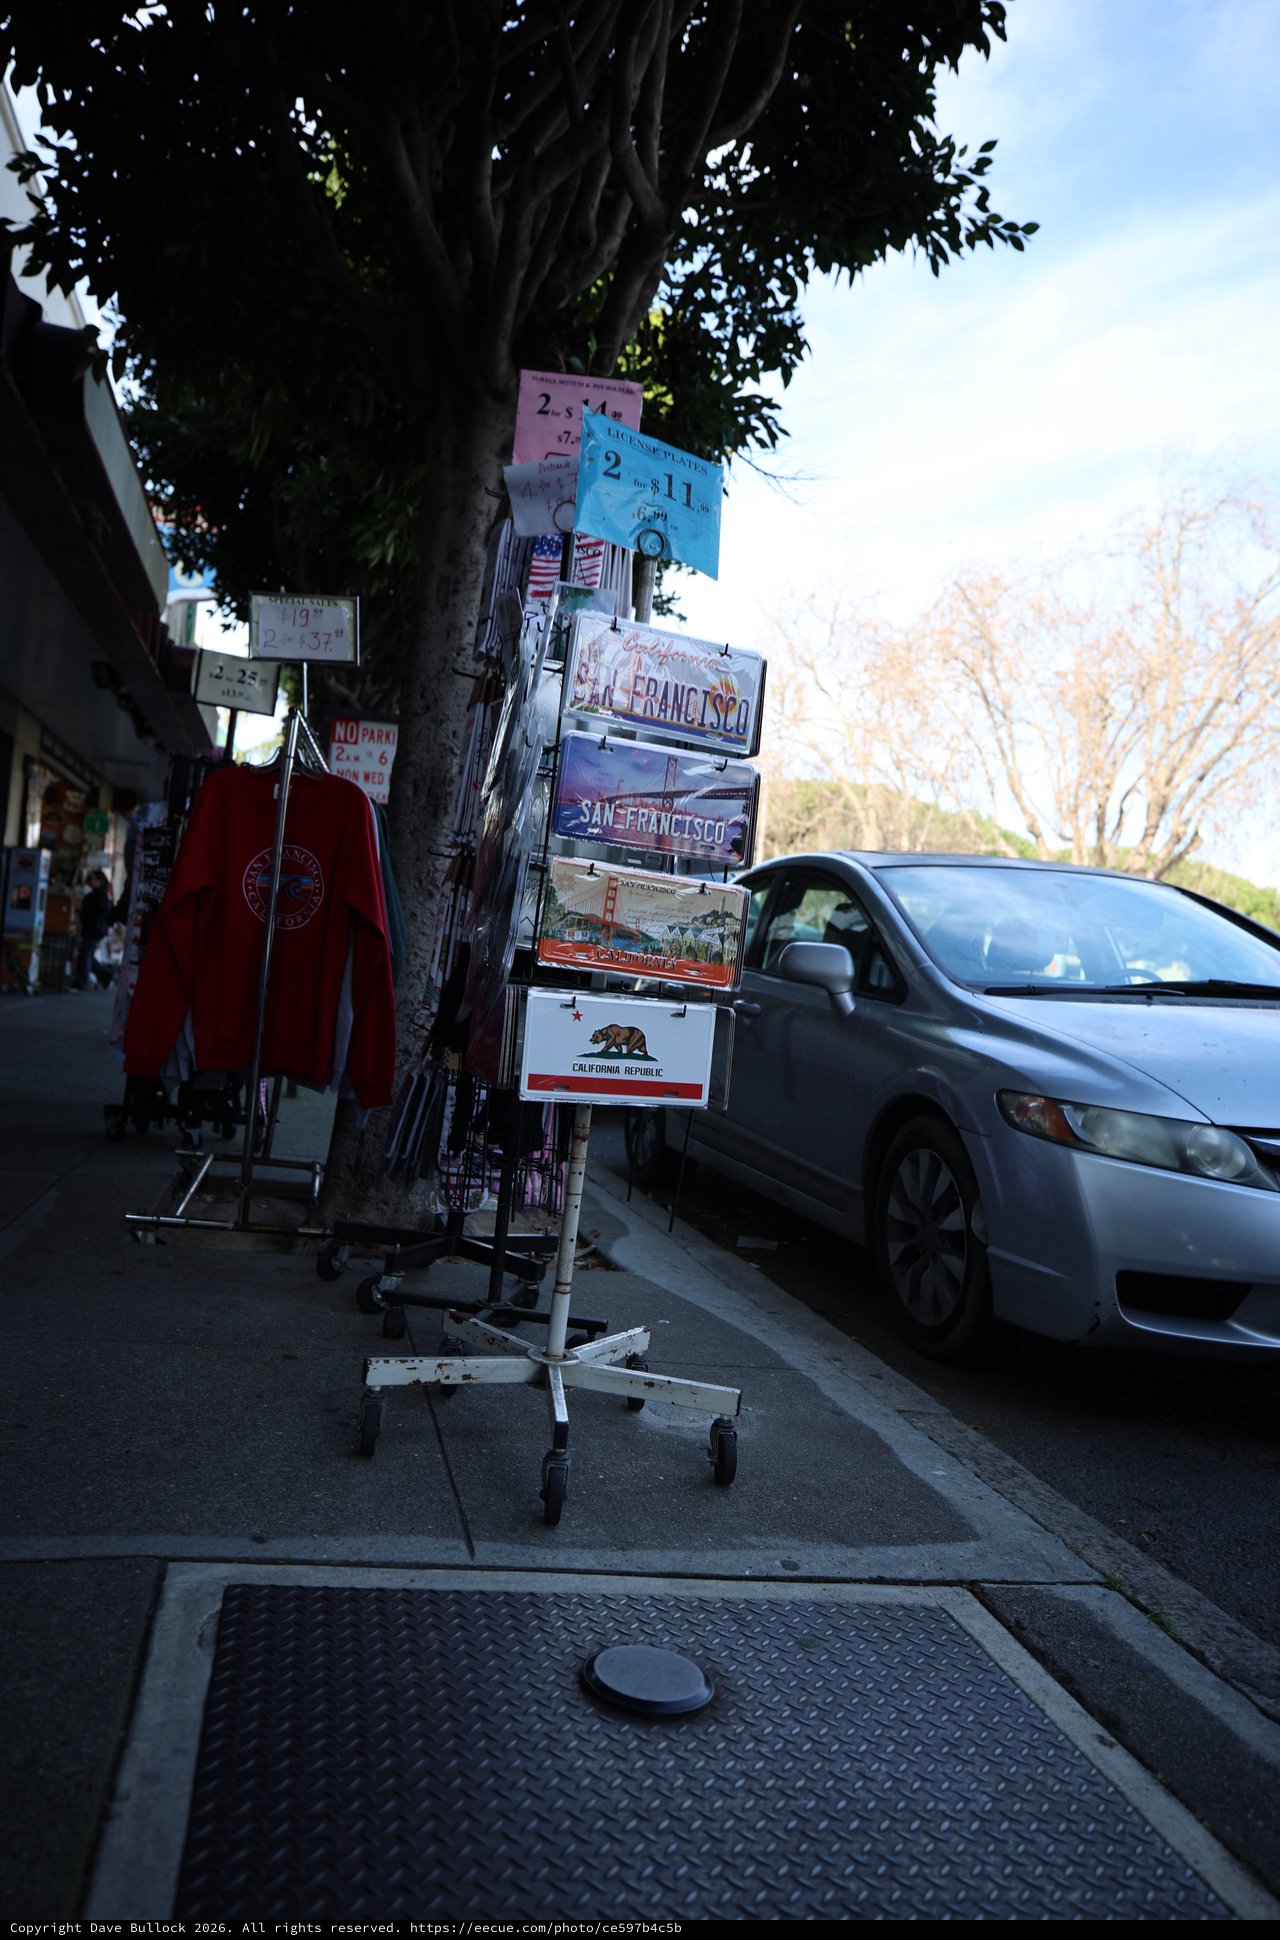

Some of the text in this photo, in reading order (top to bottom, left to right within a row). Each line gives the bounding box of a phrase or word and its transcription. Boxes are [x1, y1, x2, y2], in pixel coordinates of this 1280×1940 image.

[536, 393, 551, 415] 2
[608, 427, 709, 476] LICENSE PLATES
[602, 450, 621, 480] 2
[634, 478, 648, 490] for
[269, 596, 338, 608] SPECIAL SALES
[263, 629, 277, 649] 2
[628, 674, 750, 737] FRANCISCO
[335, 720, 358, 743] NO
[336, 746, 345, 762] 2
[378, 751, 388, 765] 6
[363, 771, 384, 785] WED
[580, 799, 728, 846] SAN FRANCISCO
[247, 848, 321, 888] SAN FANCISCO
[619, 879, 635, 889] SAN
[635, 881, 678, 896] FRANCISCO
[248, 892, 320, 928] CALFORNIA
[596, 947, 678, 971] CALIFORNIA
[572, 1062, 664, 1078] CALIFORNIA REPUBLIC
